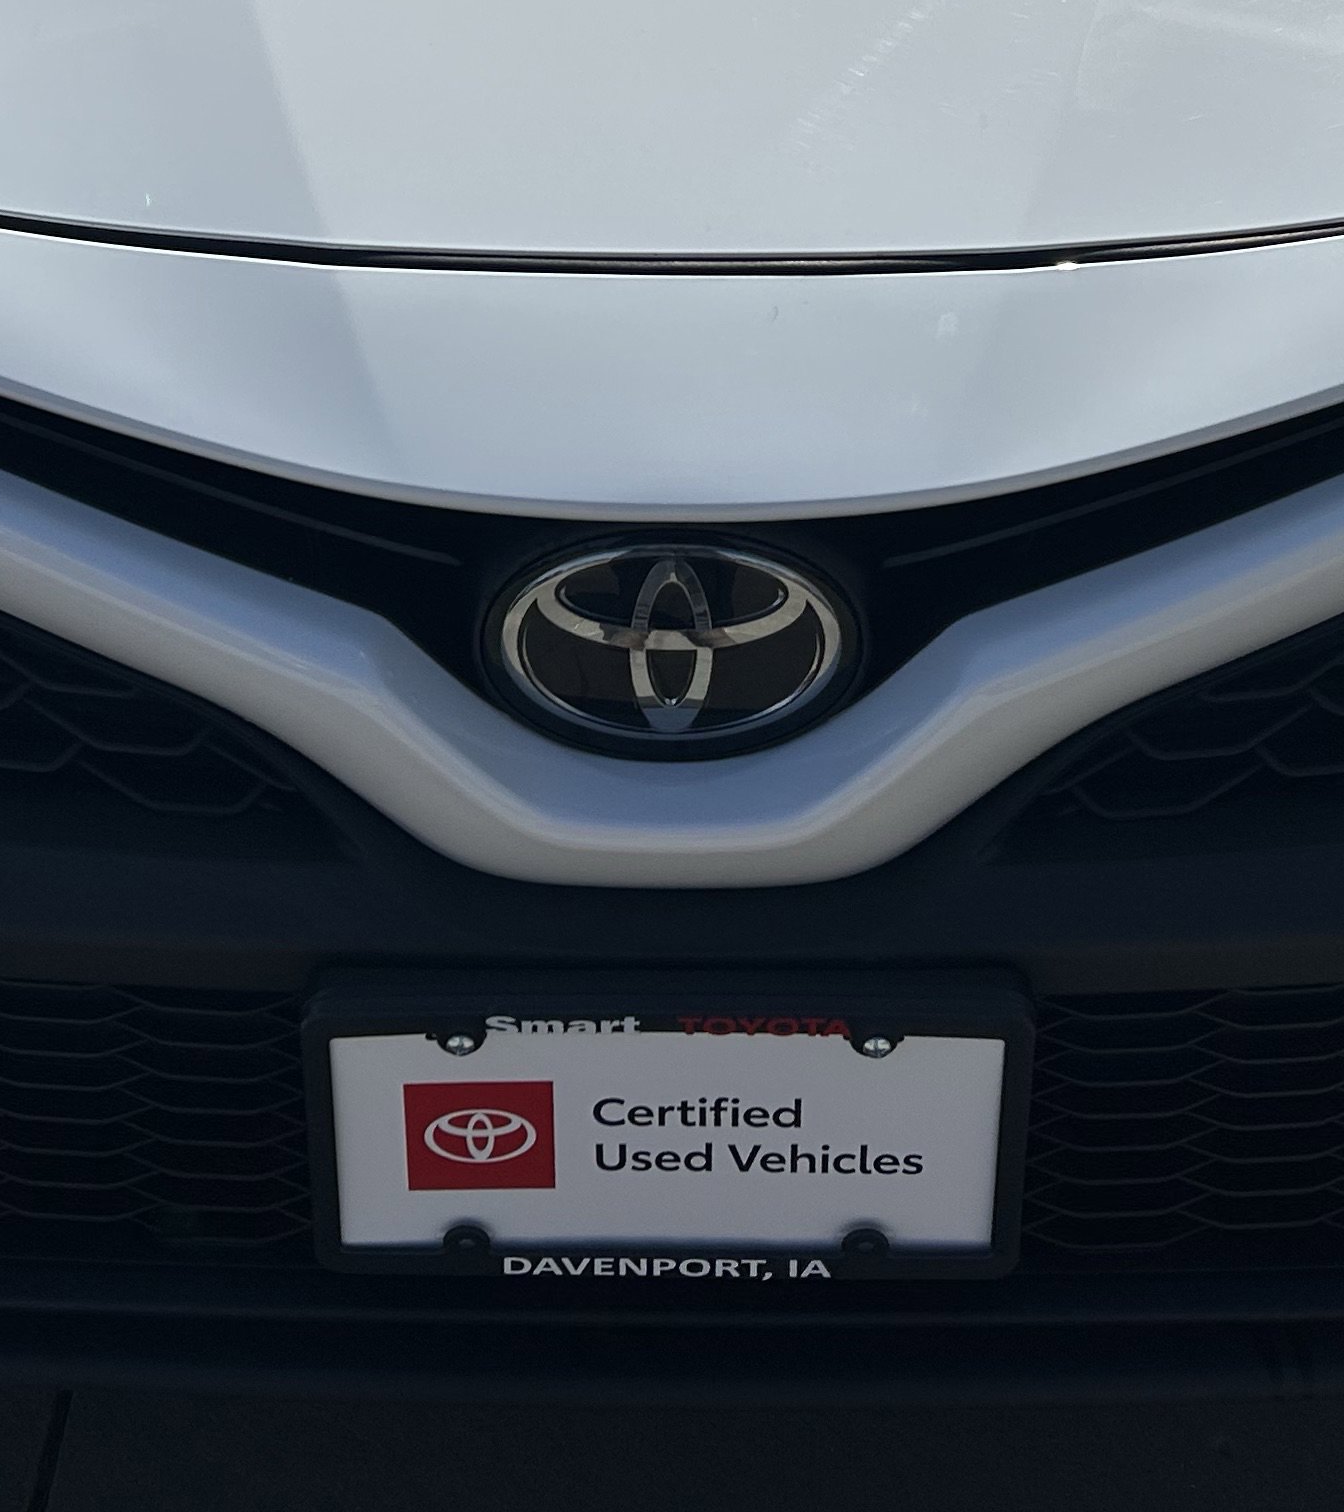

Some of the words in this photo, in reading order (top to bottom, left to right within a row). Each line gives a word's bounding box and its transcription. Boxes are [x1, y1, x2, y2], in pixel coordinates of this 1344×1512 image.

[485, 1015, 642, 1035] Smart
[676, 1016, 852, 1040] TOYOTA
[592, 1097, 803, 1128] Certified
[595, 1142, 713, 1172] Used
[727, 1143, 924, 1175] Vehicles
[502, 1255, 773, 1281] DAVENPORT,
[789, 1258, 832, 1279] IA
